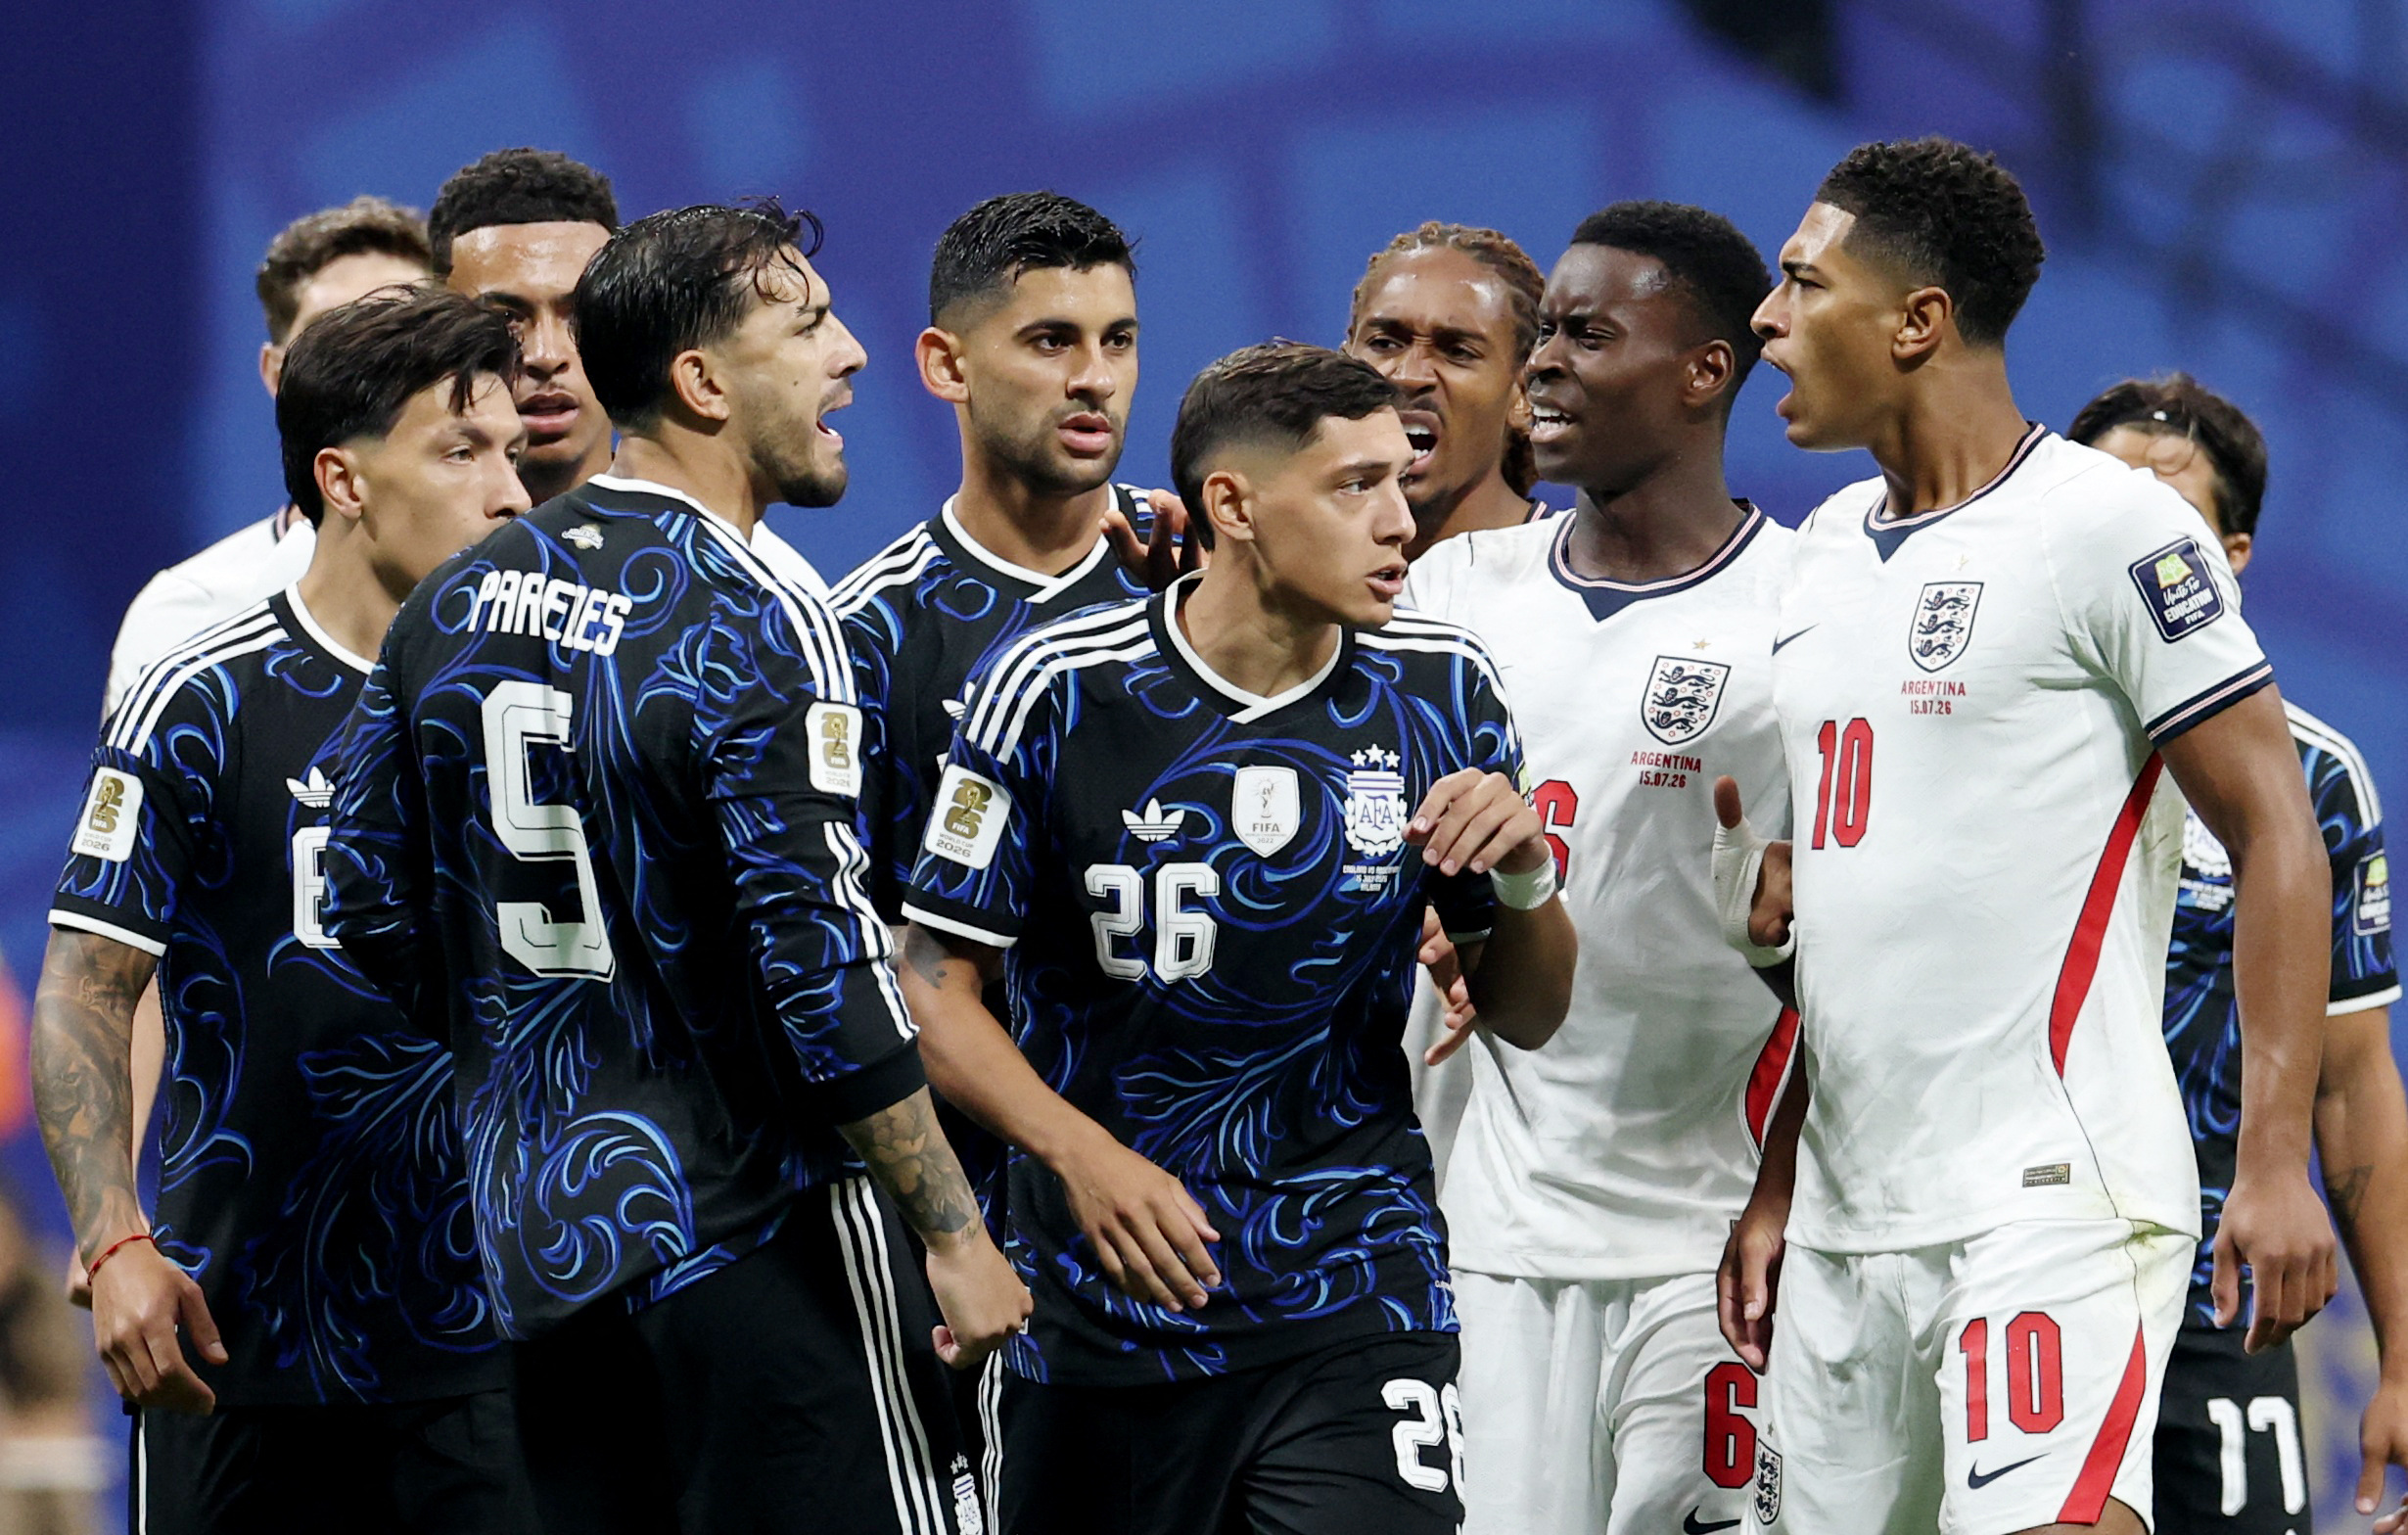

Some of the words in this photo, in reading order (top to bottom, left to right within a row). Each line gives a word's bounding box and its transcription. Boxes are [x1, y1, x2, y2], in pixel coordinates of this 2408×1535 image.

[467, 570, 632, 657] PAREDES
[2163, 587, 2214, 624] EDUCATION
[2185, 610, 2206, 625] FIFA
[1901, 680, 1967, 696] ARGENTINA
[1910, 699, 1952, 715] 15.07.26
[1631, 751, 1702, 773] ARGENTINA
[1640, 770, 1687, 788] 15.07.26
[1811, 718, 1875, 850] 10
[482, 679, 617, 983] 5
[951, 822, 970, 835] FIFA
[1252, 822, 1280, 832] FIFA
[936, 838, 972, 859] 2026
[1084, 861, 1220, 984] 26
[1959, 1311, 2064, 1445] 10
[1702, 1361, 1758, 1490] 6
[2206, 1396, 2306, 1517] 17
